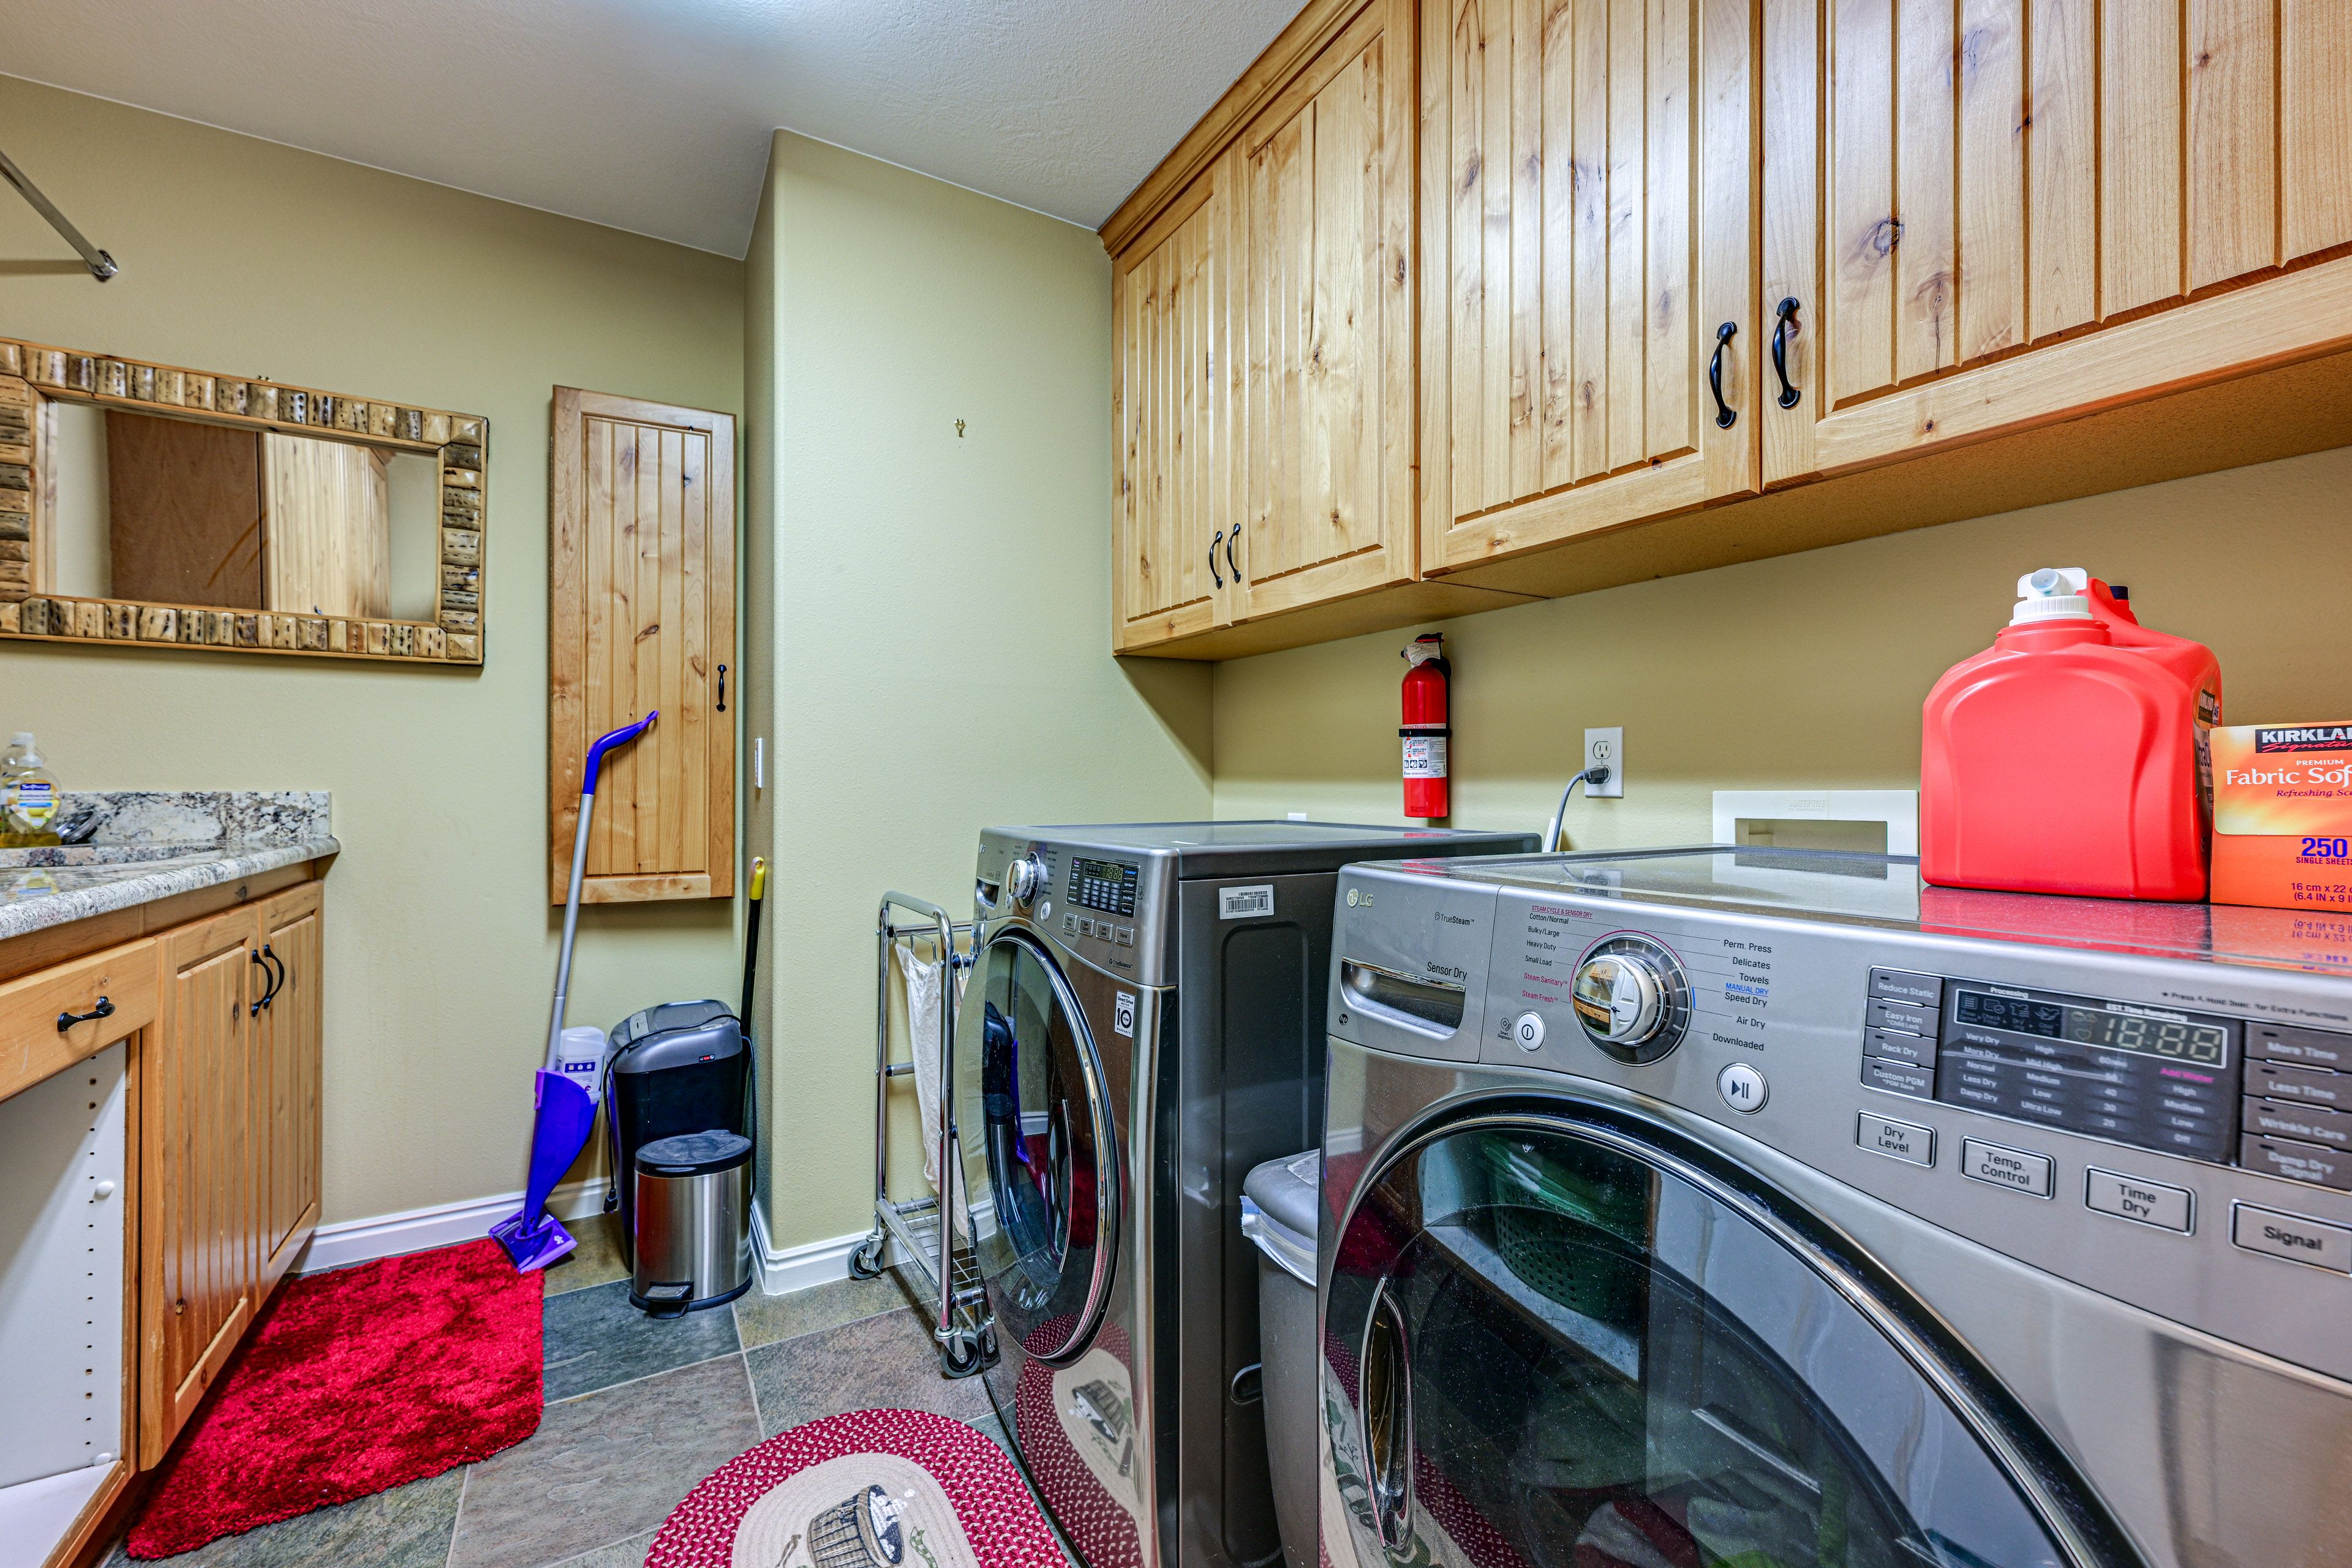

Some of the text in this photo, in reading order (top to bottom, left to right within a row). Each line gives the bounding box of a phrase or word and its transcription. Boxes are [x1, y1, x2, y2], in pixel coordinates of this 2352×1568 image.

[2226, 768, 2301, 785] Fabric
[2276, 790, 2333, 798] Refreshing
[2301, 837, 2348, 858] 250
[1359, 892, 1373, 907] LG
[2294, 892, 2313, 901] (6.4
[1529, 913, 1569, 924] Cotton/Normal
[1528, 926, 1560, 937] Bulky/Large
[1526, 940, 1556, 952] Heavy Duty
[1724, 940, 1772, 953] Perm. Press
[1525, 956, 1539, 964] Small
[1732, 957, 1770, 970] Delicates
[1427, 962, 1468, 981] Sensor Dry
[1524, 973, 1540, 982] Steam
[1740, 973, 1770, 985] Towels
[1725, 982, 1754, 993] MANUAL
[1878, 982, 1935, 998] Reduce Static
[1522, 990, 1538, 1000] Steam
[1725, 992, 1768, 1008] Speed Dry
[1117, 1008, 1132, 1028] 10
[1736, 1016, 1766, 1030] Air Dry
[1885, 1011, 1923, 1023] Easy Iron
[1713, 1033, 1764, 1051] Downloaded
[1966, 1033, 2000, 1046] Very Dry
[1882, 1043, 1918, 1058] Rack Dry
[1964, 1046, 2000, 1060] More Dry
[2035, 1044, 2055, 1055] High
[2267, 1041, 2338, 1060] More Time
[1966, 1061, 1995, 1072] Normal
[2042, 1061, 2062, 1071] High
[1874, 1069, 1925, 1088] Custom PGM
[1963, 1074, 1997, 1088] Less Dry
[2026, 1072, 2060, 1085] Medium
[1960, 1088, 1998, 1102] Damp Dry
[2032, 1088, 2052, 1099] Low
[2104, 1088, 2117, 1096] 40
[2173, 1085, 2196, 1096] High
[2268, 1080, 2336, 1100] Less Time
[2021, 1101, 2062, 1116] Ultra Low
[2103, 1102, 2117, 1112] 30
[2163, 1099, 2204, 1114] Medium
[2103, 1118, 2116, 1128] 20
[2171, 1117, 2195, 1128] Low
[2258, 1116, 2347, 1142] Wrinkle Care
[1884, 1126, 1904, 1141] Dry
[1878, 1136, 1909, 1153] Level
[1986, 1152, 2026, 1171] Temp.
[2267, 1151, 2335, 1174] Damp Dry
[1981, 1164, 2030, 1185] Control
[2280, 1164, 2323, 1182] Signal
[2119, 1183, 2157, 1204] Time
[2122, 1199, 2150, 1218] Dry
[2264, 1226, 2323, 1251] Signal
